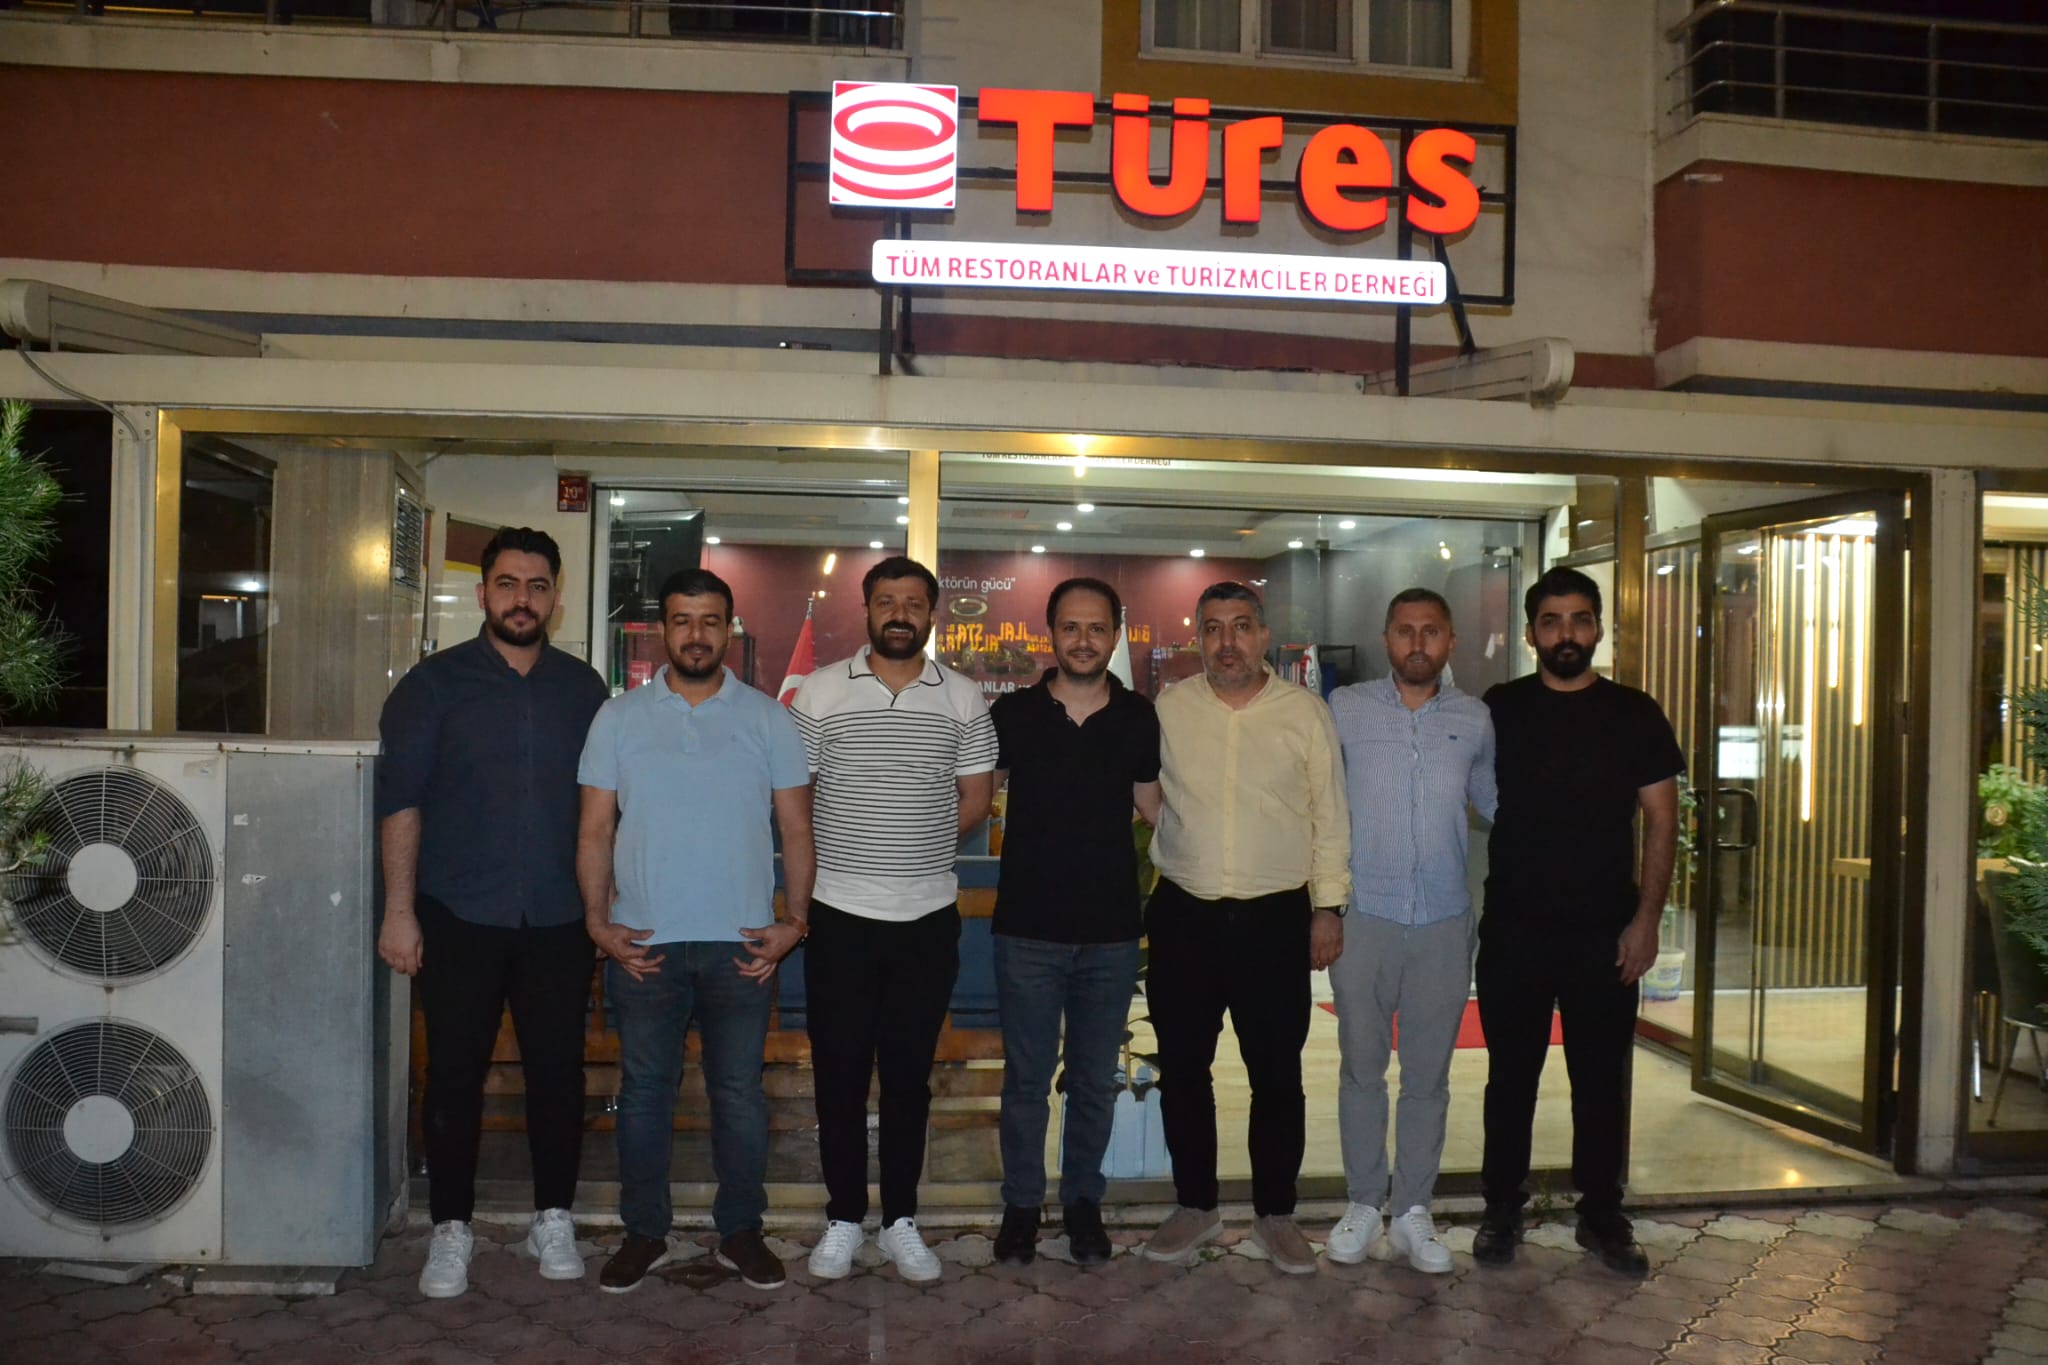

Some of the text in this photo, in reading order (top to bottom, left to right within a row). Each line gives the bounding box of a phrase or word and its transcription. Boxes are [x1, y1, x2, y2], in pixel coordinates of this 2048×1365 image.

[978, 87, 1480, 234] Türes
[886, 250, 1435, 298] TÜM RESTORANLAR ve TURİZMCİLER DERNEĞİ
